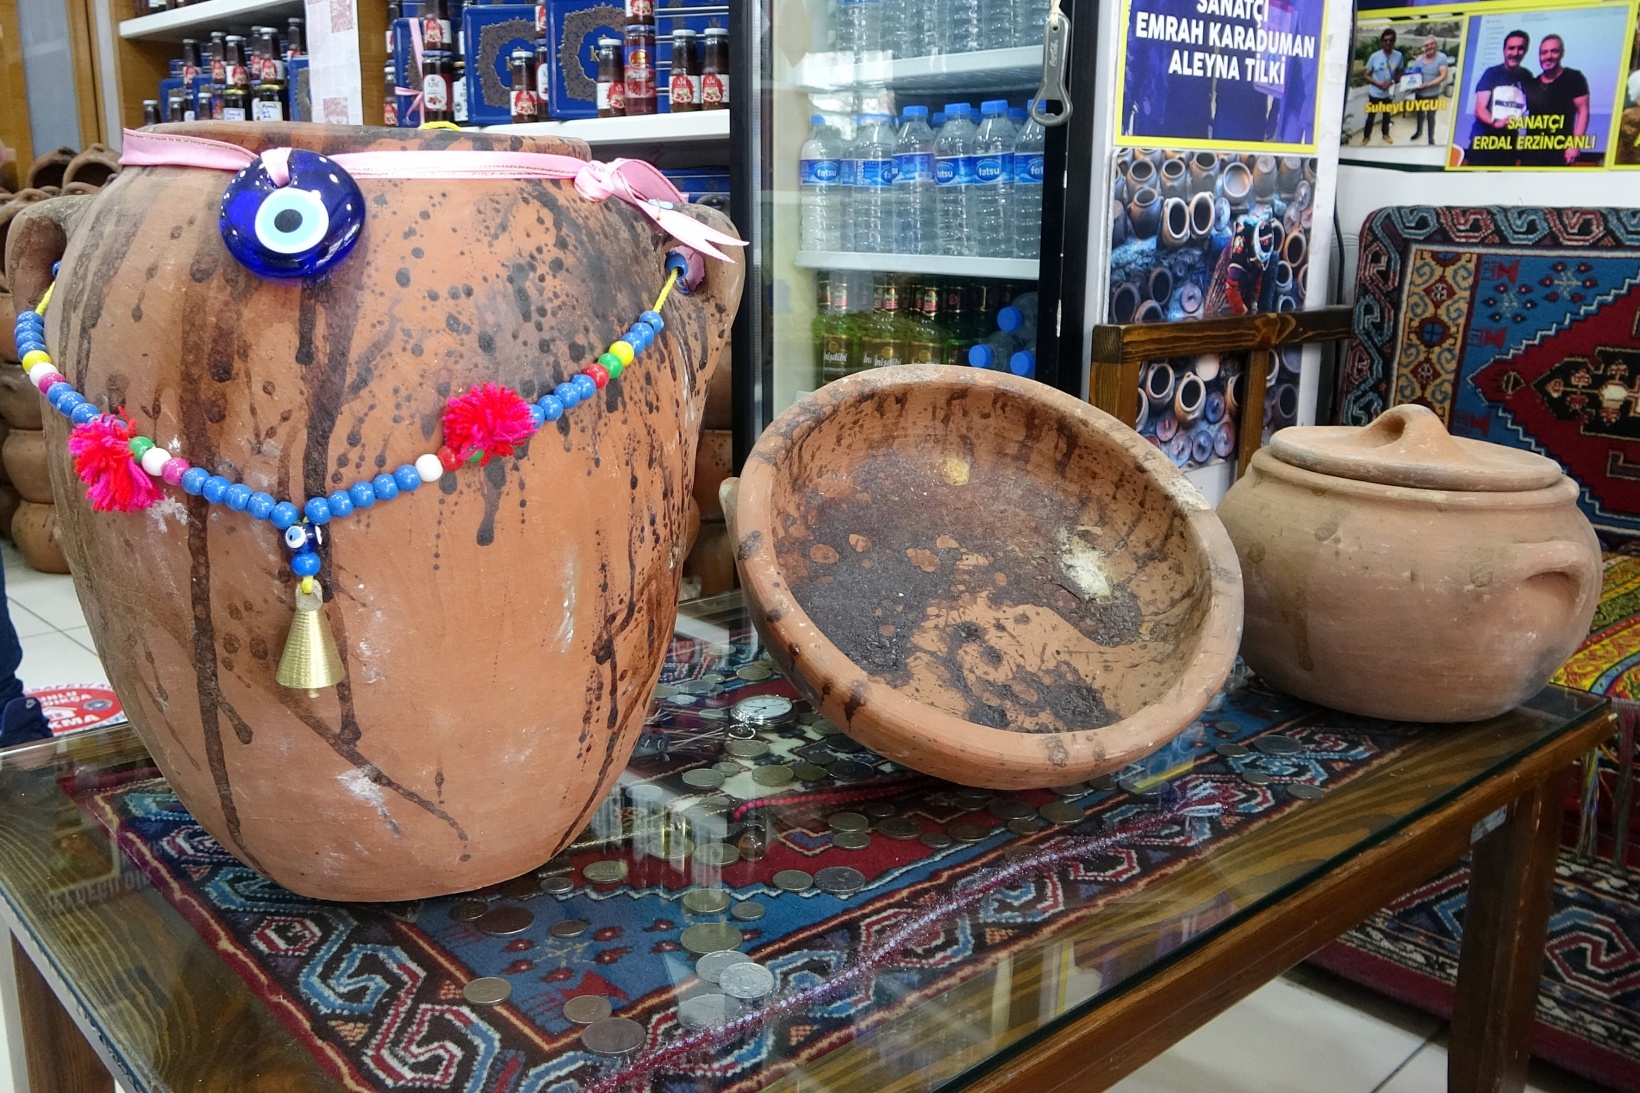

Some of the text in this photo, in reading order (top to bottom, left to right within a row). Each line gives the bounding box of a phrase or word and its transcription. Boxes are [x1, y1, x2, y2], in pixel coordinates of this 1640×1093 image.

[1136, 11, 1315, 59] EMRAH KARADUMAN
[1168, 50, 1286, 84] ALEYNA TİLKİ
[1405, 98, 1447, 112] UYGUR
[1507, 114, 1565, 133] SANATÇI
[1472, 131, 1597, 150] ERDAL ERZİNCANLI
[978, 167, 1000, 177] fatsu
[48, 714, 100, 729] KMA
